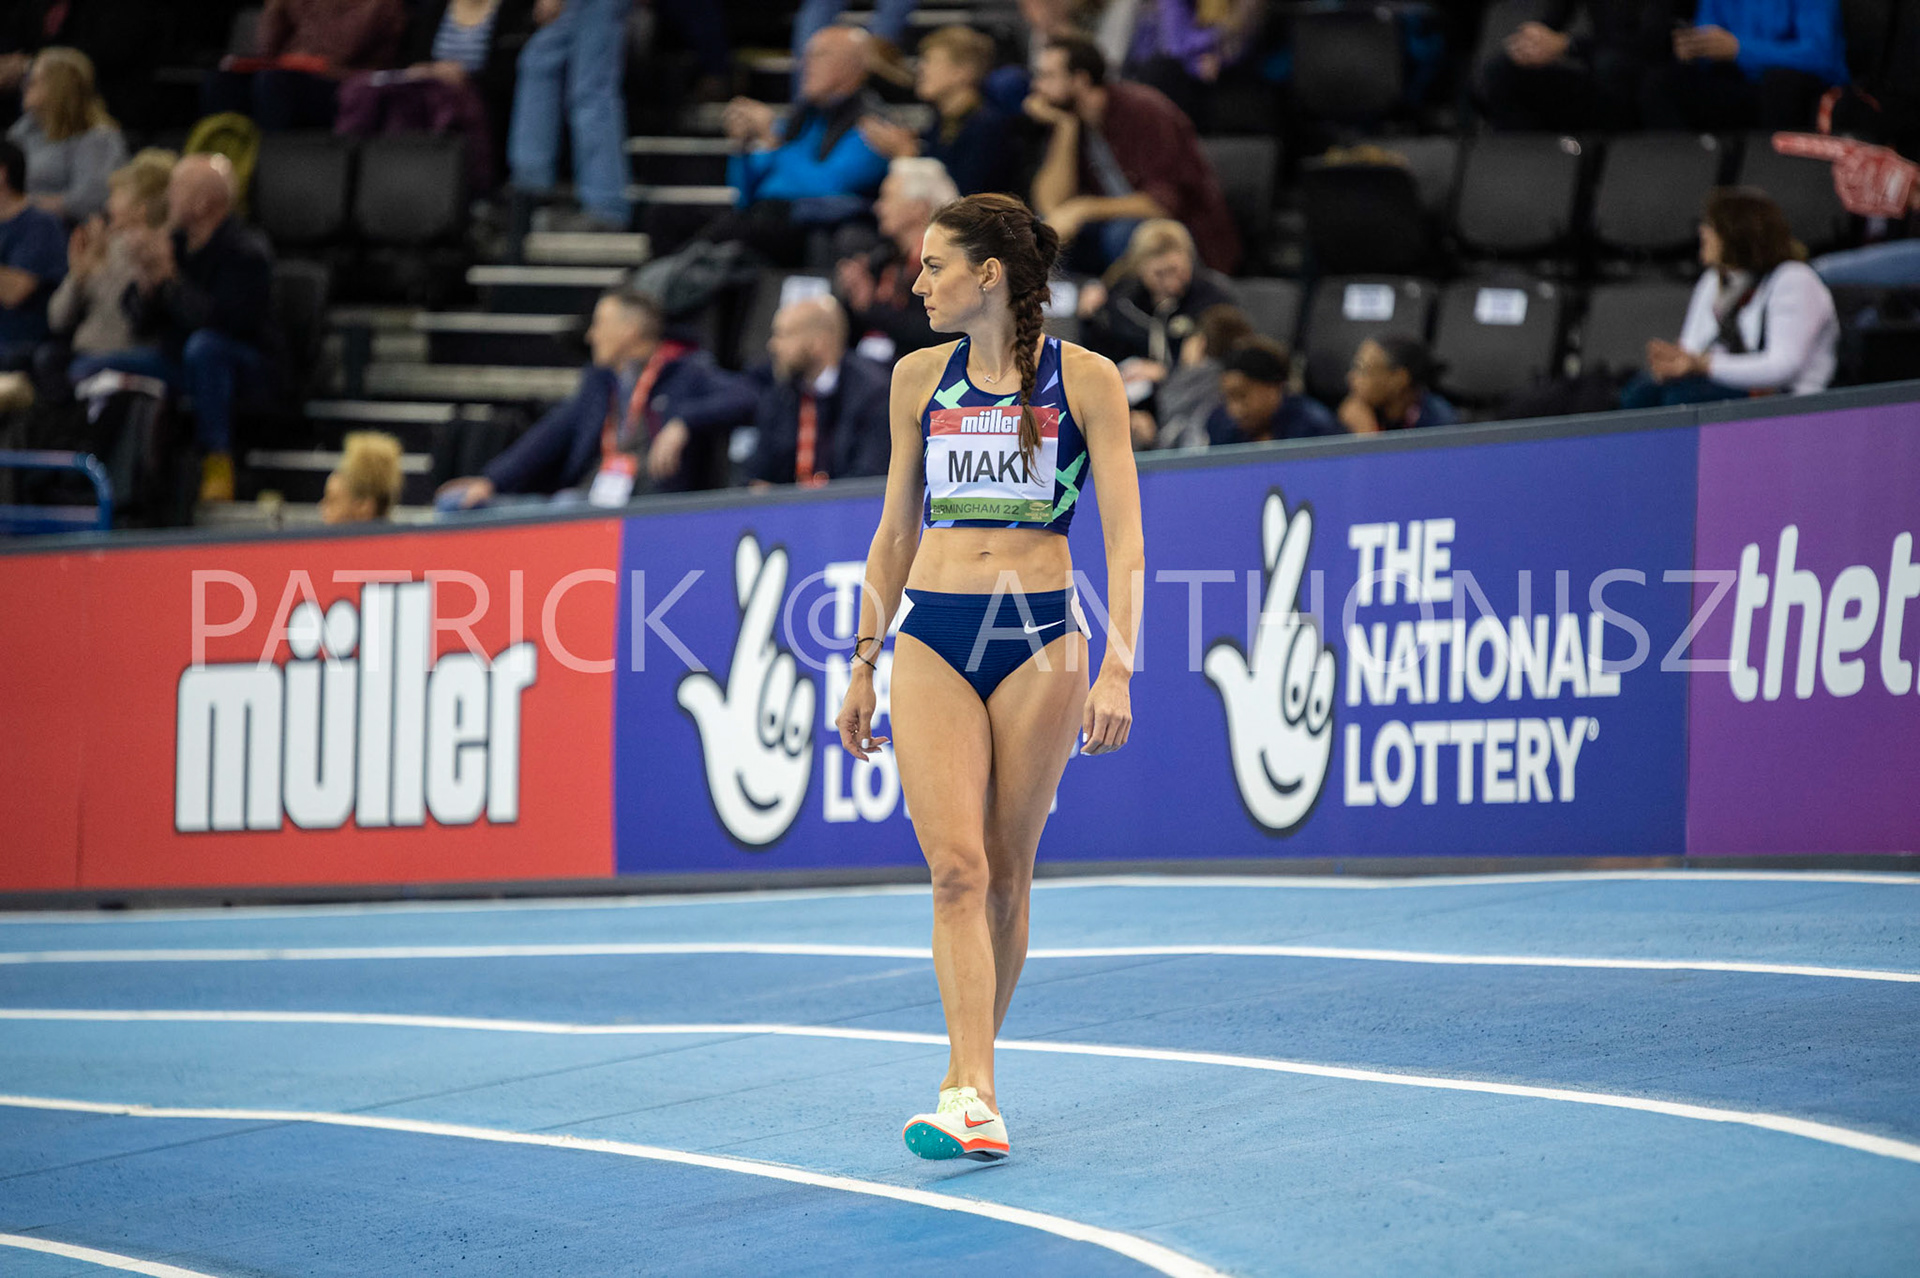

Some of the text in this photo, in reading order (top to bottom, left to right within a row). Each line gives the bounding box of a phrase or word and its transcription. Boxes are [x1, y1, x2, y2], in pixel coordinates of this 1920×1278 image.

[961, 409, 1021, 433] müller
[948, 450, 1029, 484] MAKI
[1003, 504, 1020, 515] 22
[1348, 517, 1456, 607] THE
[1345, 610, 1622, 707] NATIONAL
[1728, 524, 1920, 703] thet
[174, 579, 538, 835] müller
